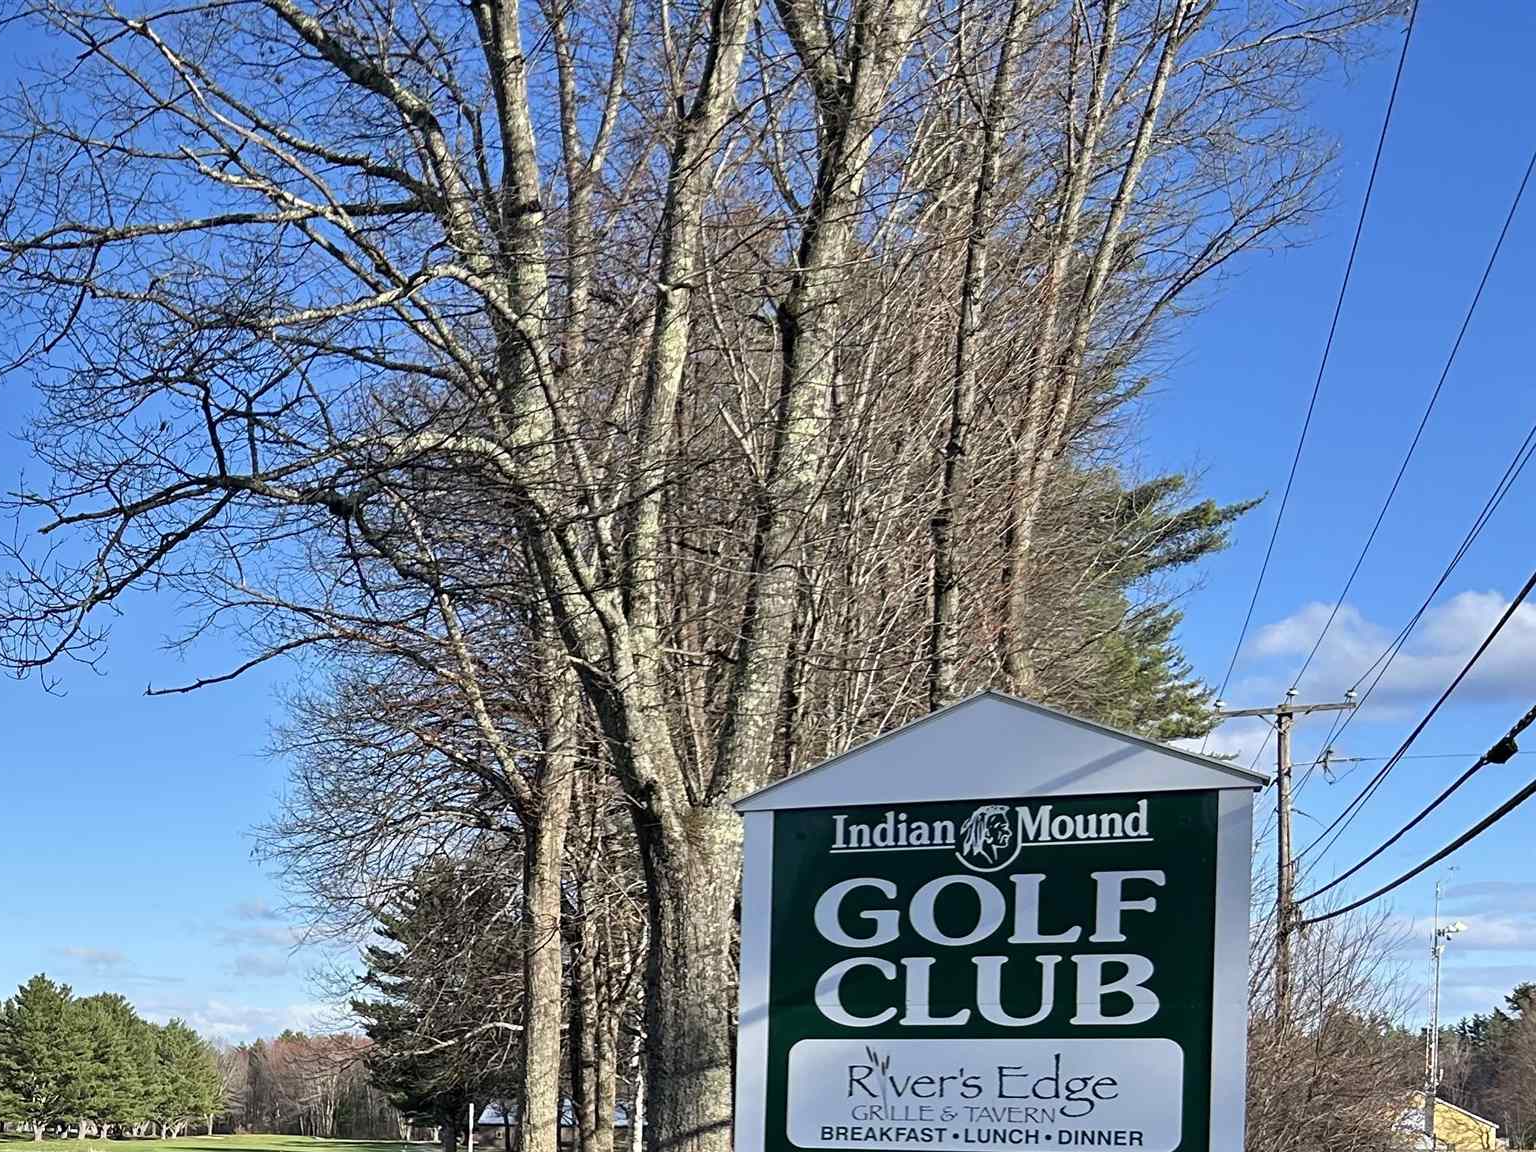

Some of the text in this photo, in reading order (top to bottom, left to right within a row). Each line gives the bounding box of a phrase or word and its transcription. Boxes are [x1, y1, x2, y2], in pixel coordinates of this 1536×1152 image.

[831, 799, 1148, 850] Indian Mound
[814, 870, 1166, 948] GOLF
[814, 953, 1161, 1027] CLUB
[998, 1053, 1119, 1117] Edge
[821, 1126, 1144, 1147] BREAKFAST LUNCH DINNER
[852, 1105, 935, 1123] GRILLE
[964, 1106, 1056, 1124] TAVERN
